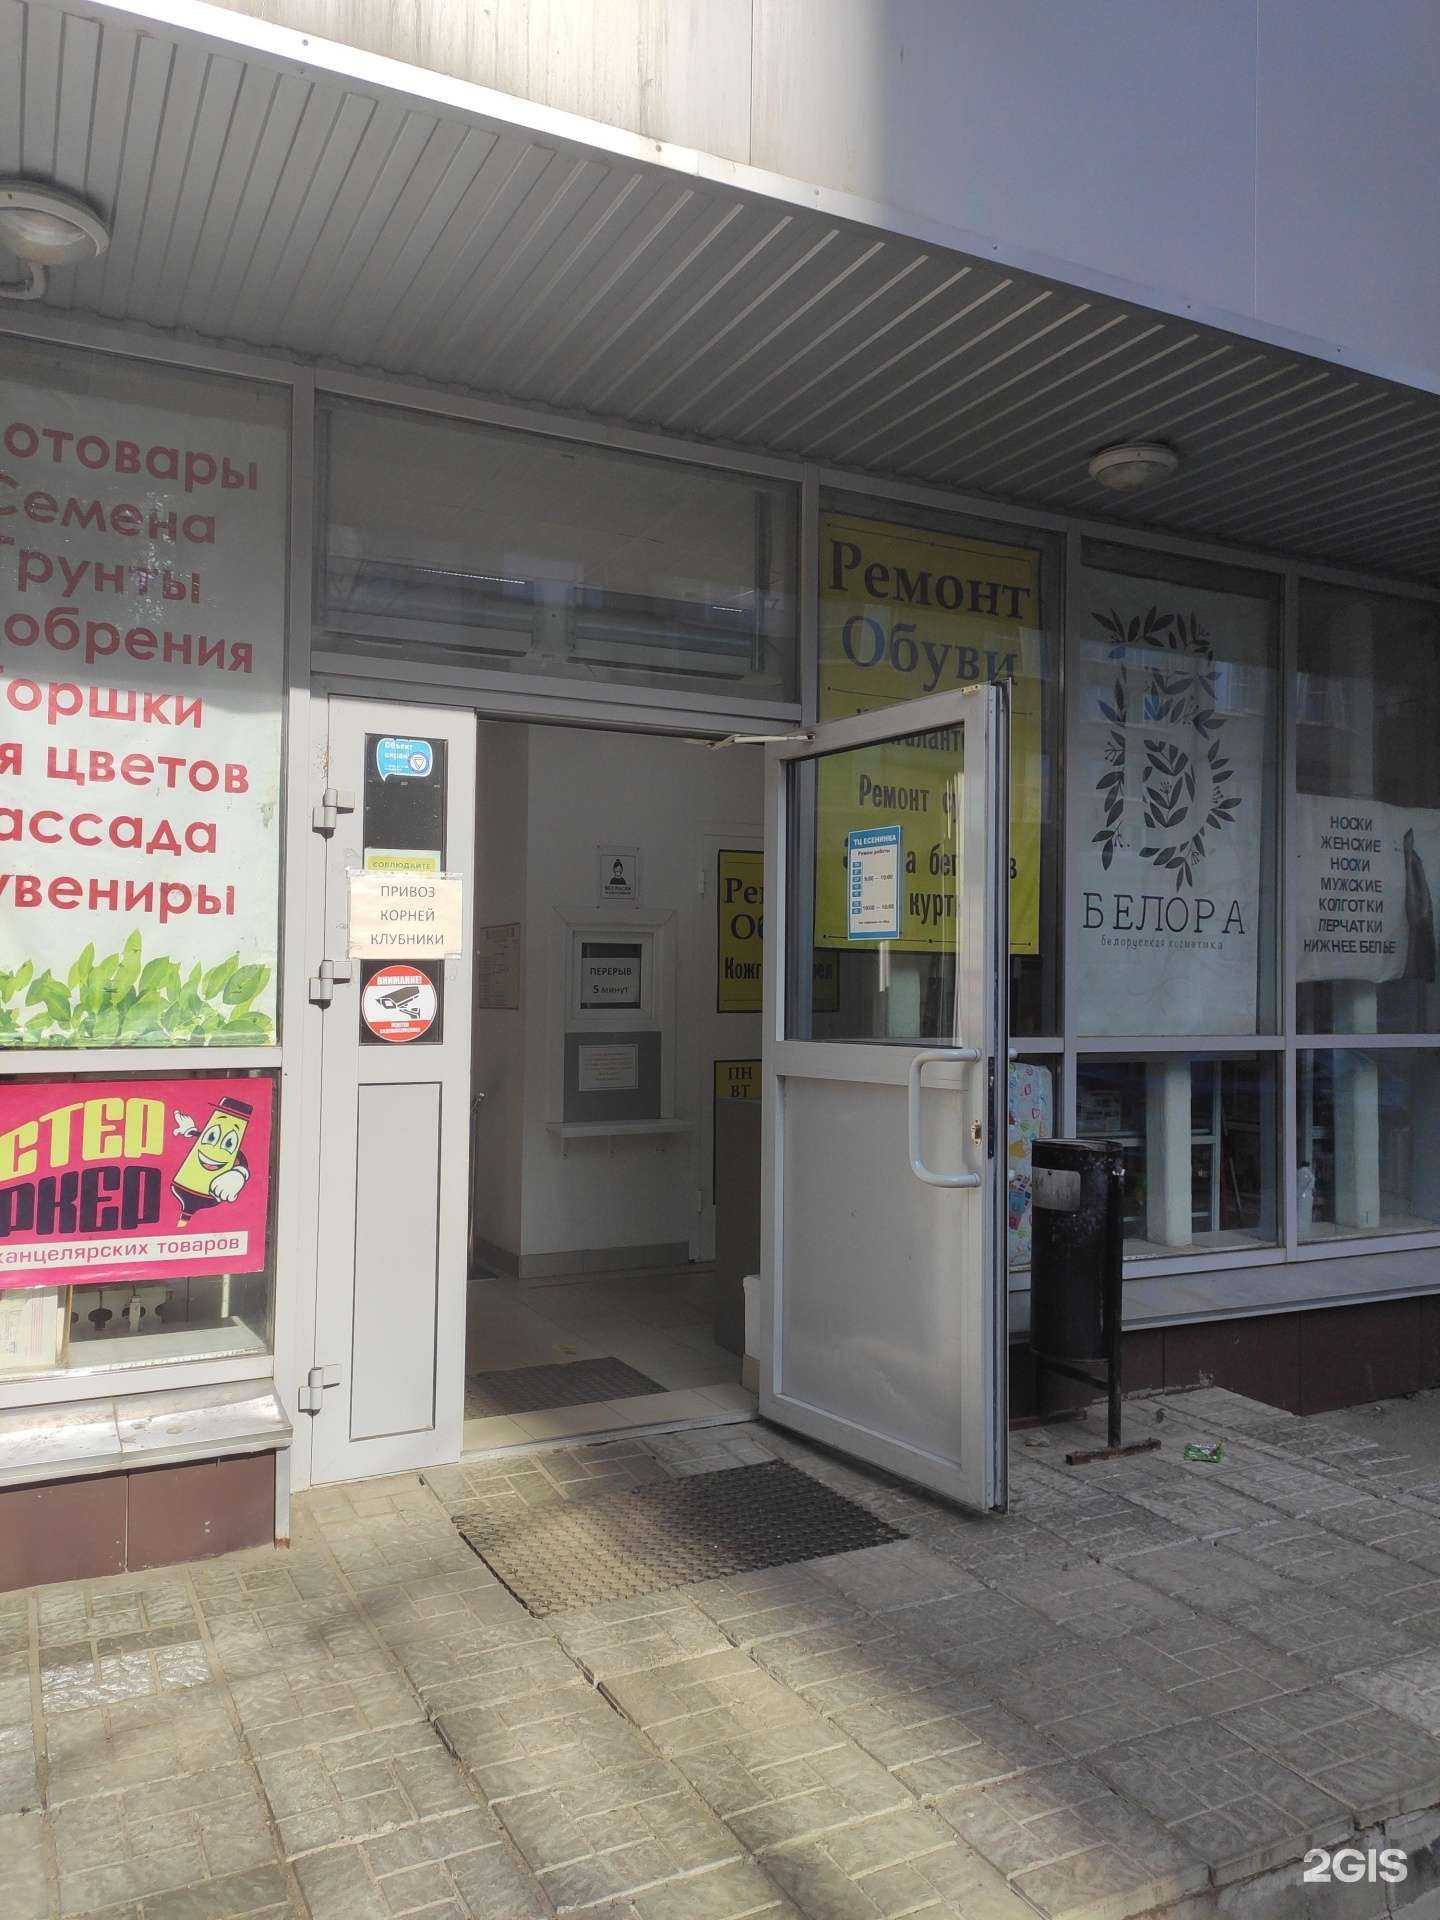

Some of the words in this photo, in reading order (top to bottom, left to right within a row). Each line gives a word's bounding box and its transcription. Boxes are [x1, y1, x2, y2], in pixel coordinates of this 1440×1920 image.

[0, 535, 201, 604] рунты
[828, 537, 1031, 619] Ремонт
[842, 615, 1018, 692] Обуви
[0, 665, 203, 728] оршки
[47, 746, 249, 794] цветов
[859, 773, 930, 813] Ремонт
[1330, 816, 1372, 831] НОСКИ
[1321, 836, 1381, 853] ЖЕНСКИЕ
[1330, 857, 1370, 872] НОСКИ
[381, 885, 435, 898] ПРИВОЗ
[1320, 877, 1382, 893] МУЖСКИЕ
[1083, 892, 1245, 934] БЕЛОРА
[1319, 898, 1383, 913] КОЛГОТКИ
[380, 908, 435, 922] КОРНЕЙ
[1318, 918, 1383, 933] ПЕРЧАТКИ
[371, 933, 444, 945] КЛУБНИКИ
[1304, 939, 1357, 953] НИЖНЕЕ
[1359, 940, 1396, 954] БЕЛЬЕ
[590, 967, 632, 976] ПЕРЕРЫВ
[593, 984, 599, 994] 5
[728, 1066, 752, 1081] ПН
[731, 1083, 751, 1098] ВТ
[157, 1238, 239, 1255] товаров
